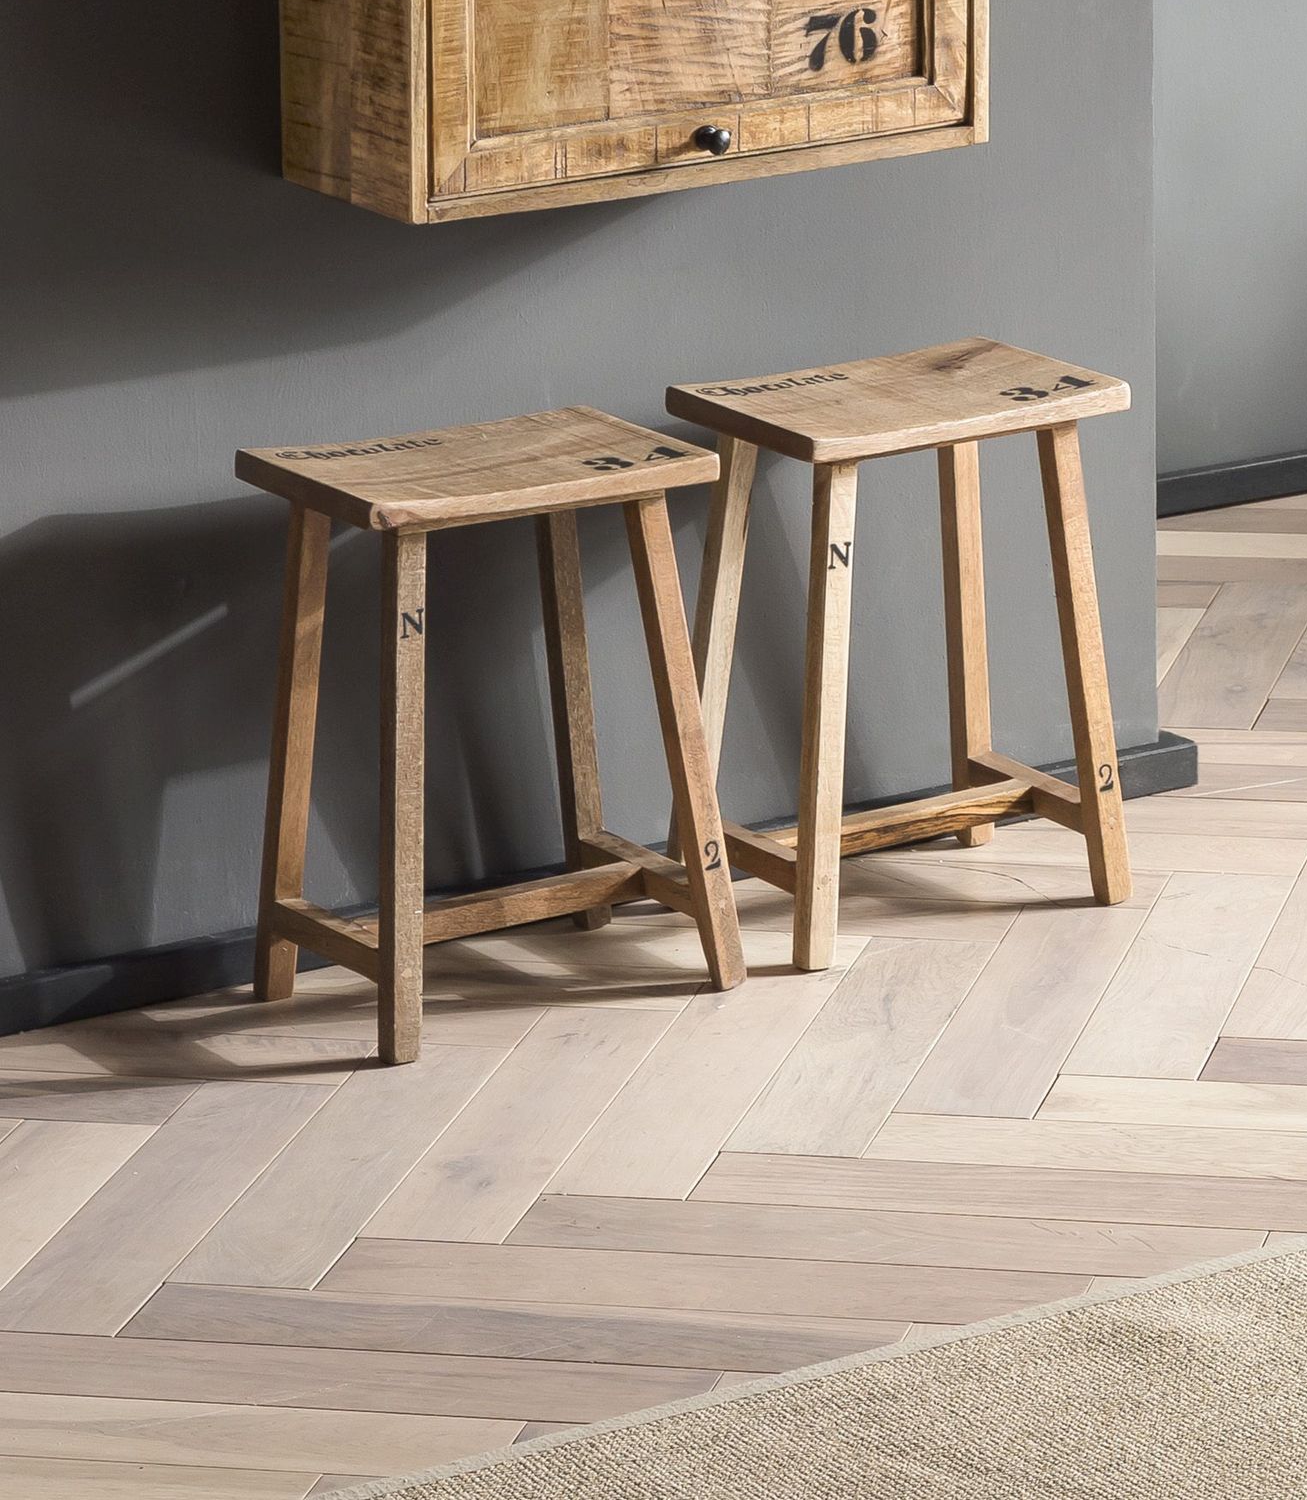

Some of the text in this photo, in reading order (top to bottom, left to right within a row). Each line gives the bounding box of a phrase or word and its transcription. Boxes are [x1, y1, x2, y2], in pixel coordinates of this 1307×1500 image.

[803, 7, 877, 72] 76
[828, 541, 852, 570] N
[400, 608, 424, 639] N
[1098, 763, 1114, 792] 2
[704, 840, 721, 870] 2
